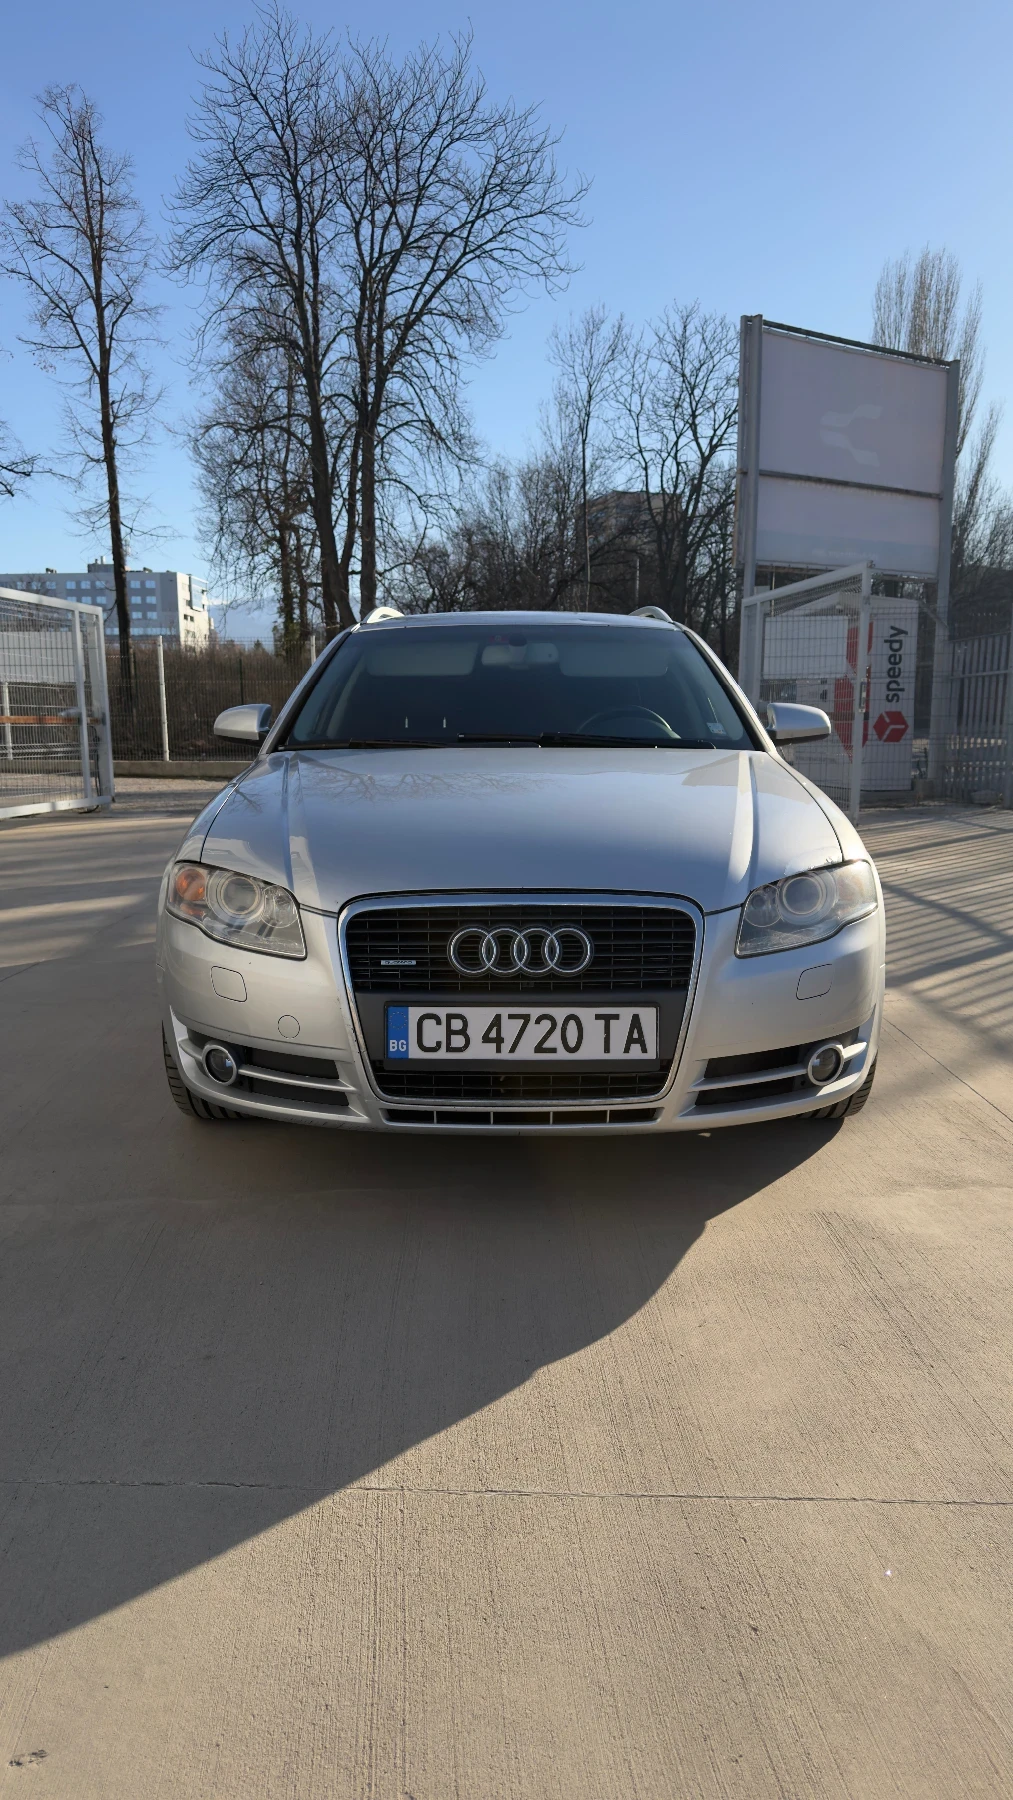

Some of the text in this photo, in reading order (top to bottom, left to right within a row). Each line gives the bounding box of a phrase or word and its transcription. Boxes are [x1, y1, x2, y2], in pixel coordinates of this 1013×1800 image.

[884, 625, 908, 703] speedy
[389, 1040, 407, 1051] BG
[416, 1013, 648, 1054] CB 4720 TA
